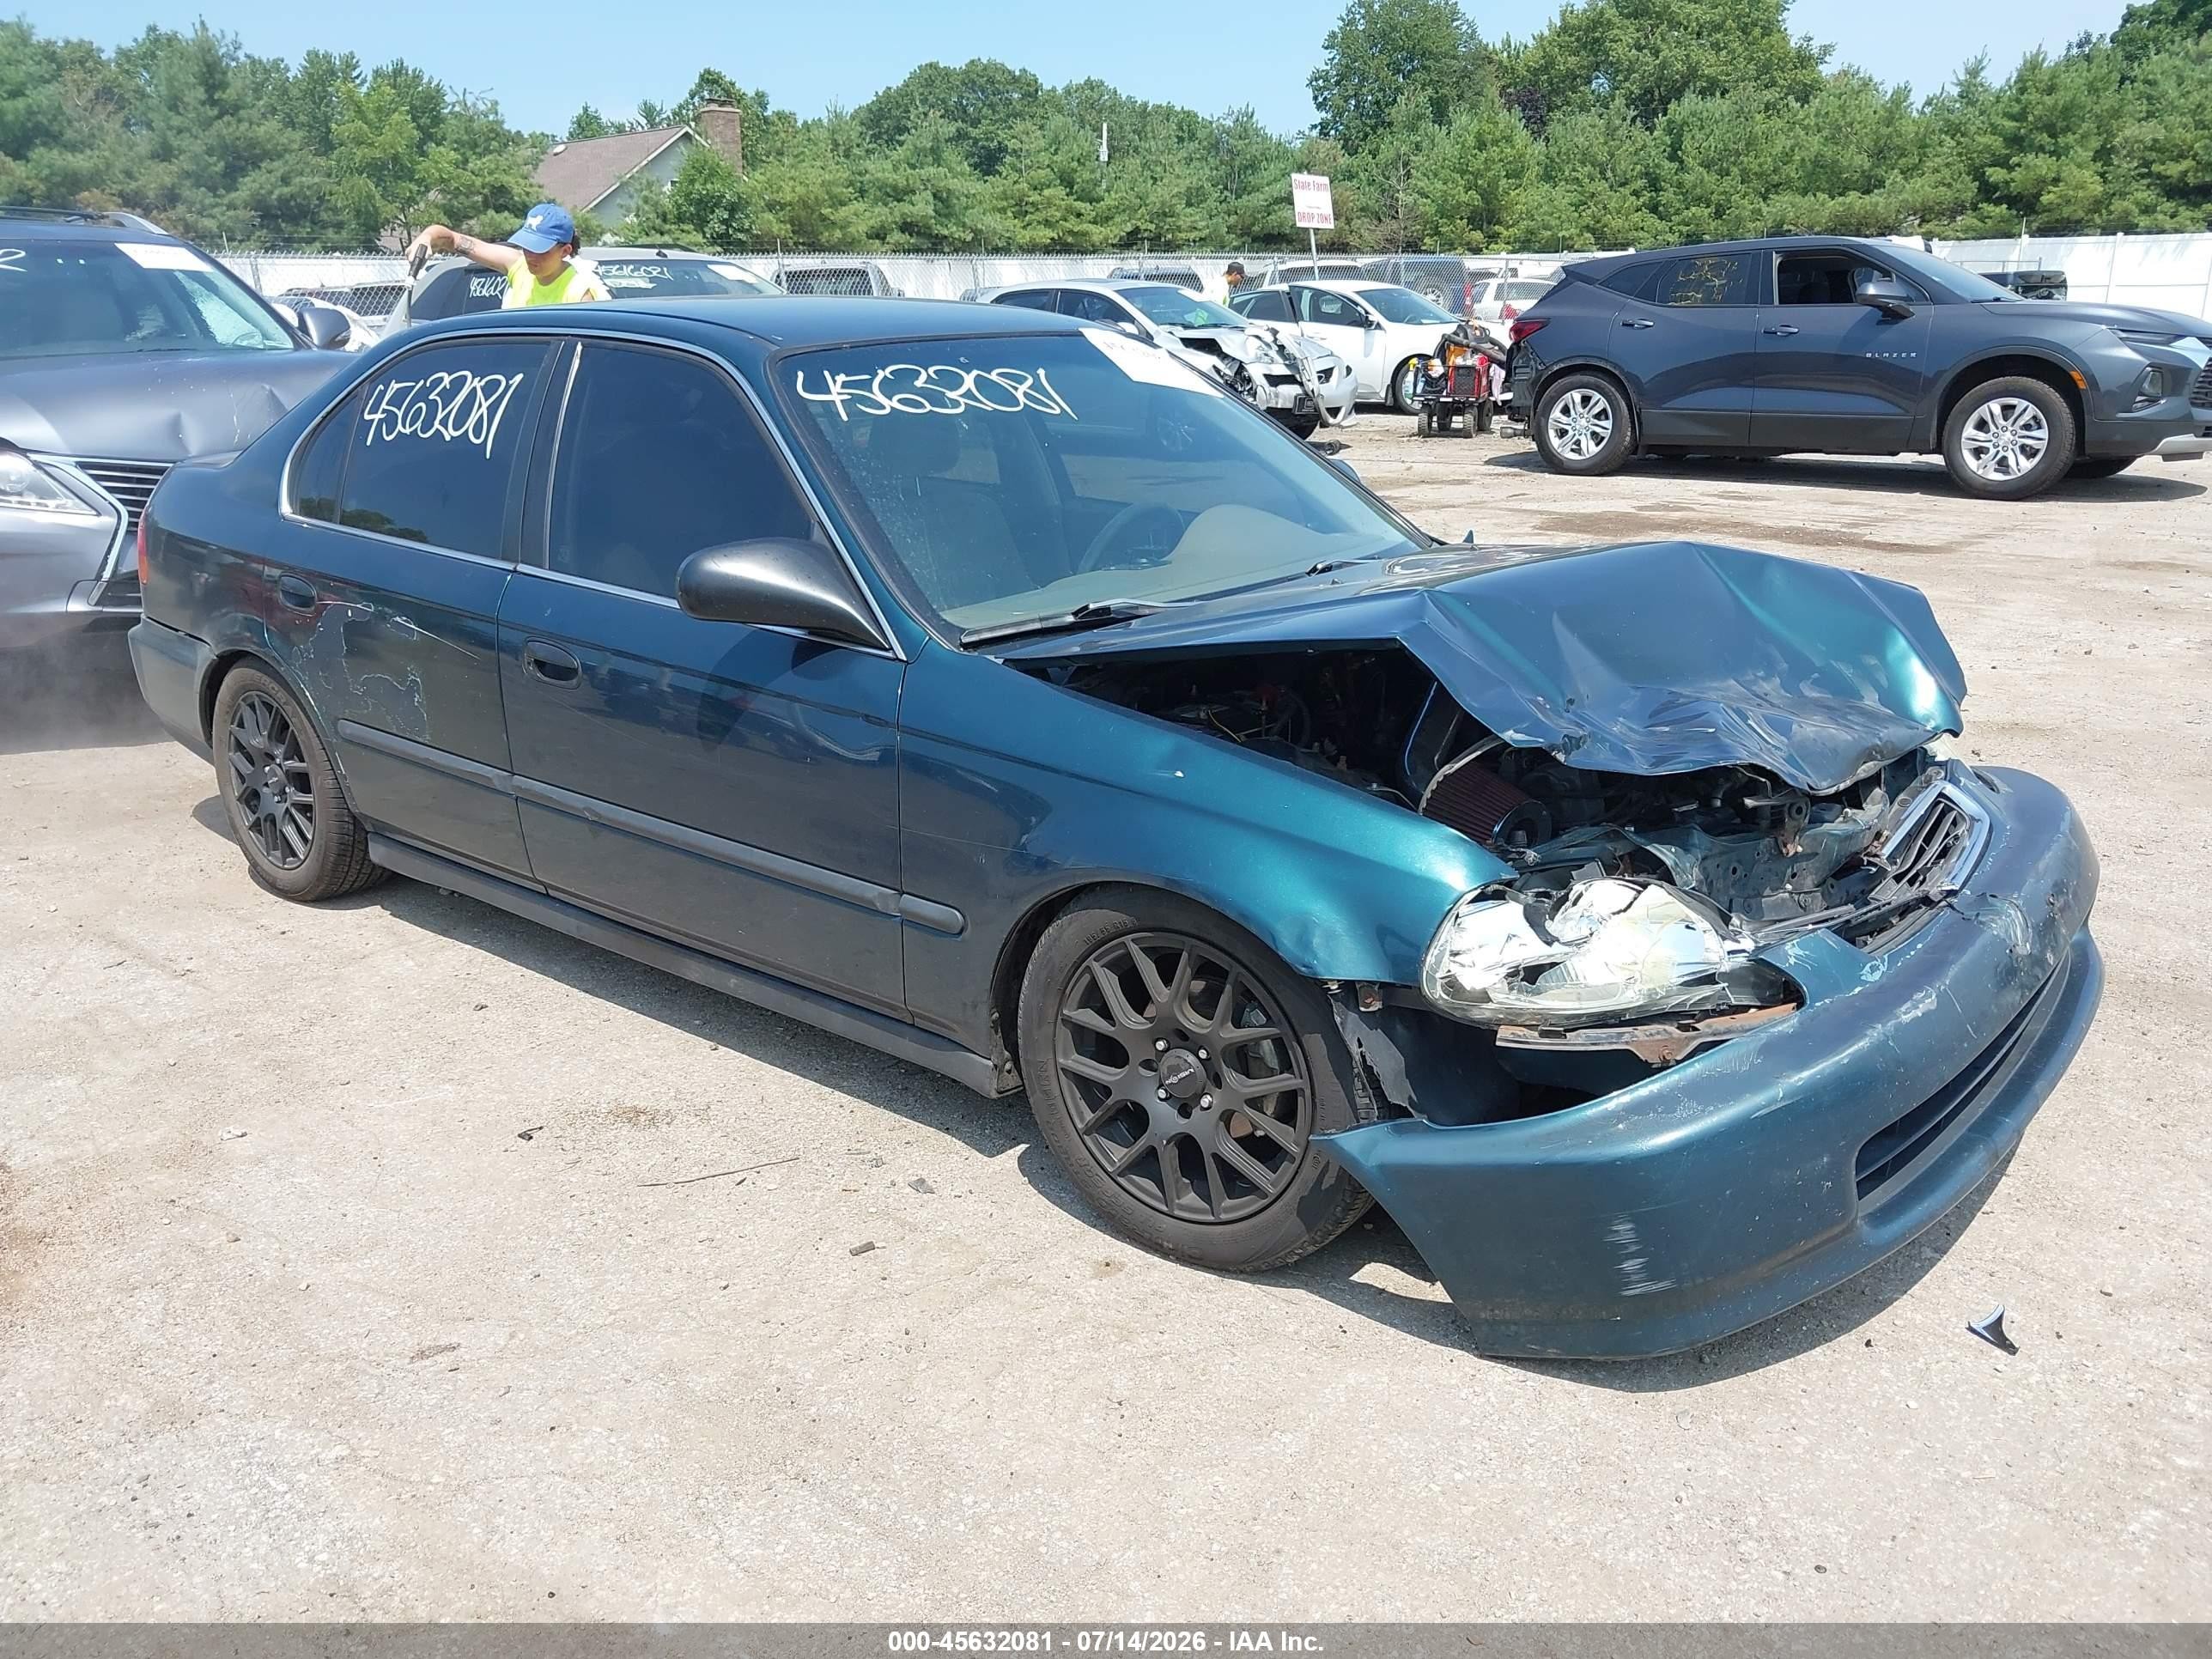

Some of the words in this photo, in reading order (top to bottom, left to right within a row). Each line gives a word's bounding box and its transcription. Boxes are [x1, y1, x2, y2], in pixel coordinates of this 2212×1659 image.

[1293, 178, 1311, 191] State
[1312, 179, 1329, 193] Farm
[1297, 211, 1316, 223] DROP
[1316, 213, 1332, 225] ZONE
[796, 364, 1078, 422] 45632081
[363, 369, 524, 460] 45632081
